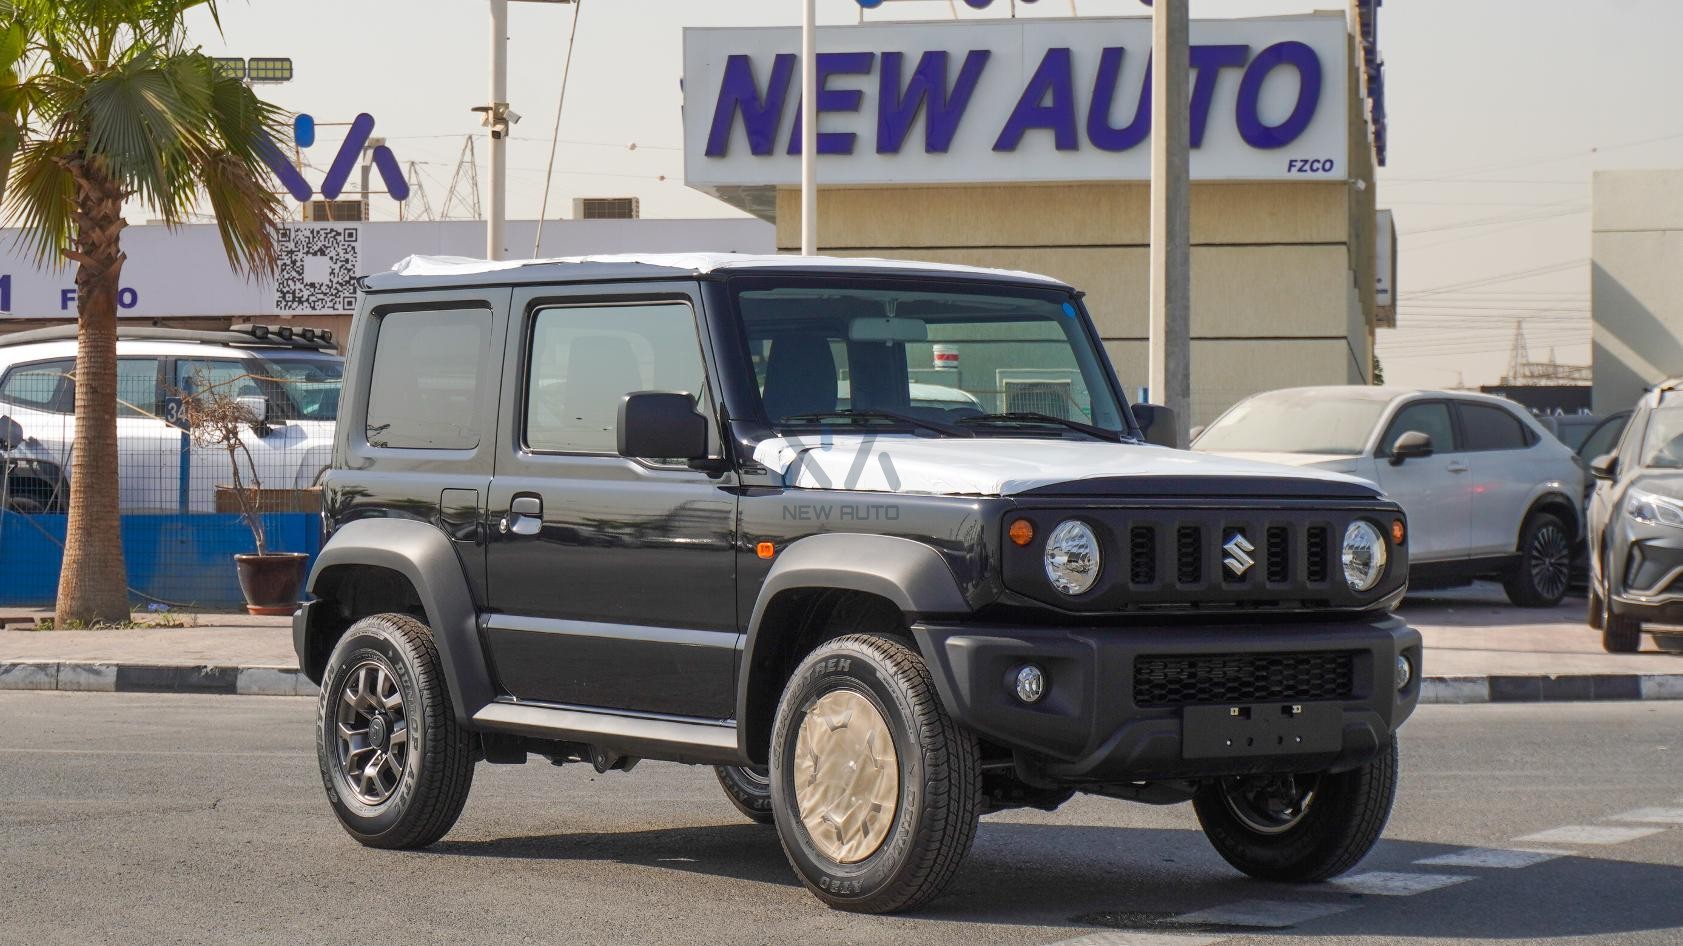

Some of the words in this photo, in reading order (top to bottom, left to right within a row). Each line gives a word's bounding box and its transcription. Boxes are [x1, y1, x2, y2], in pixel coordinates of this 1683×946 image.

[704, 49, 992, 157] NEW
[992, 40, 1322, 153] AUTO
[1287, 158, 1335, 173] FZCO
[61, 287, 138, 310] FO
[167, 402, 187, 423] 34
[395, 662, 419, 752] DUNLOP
